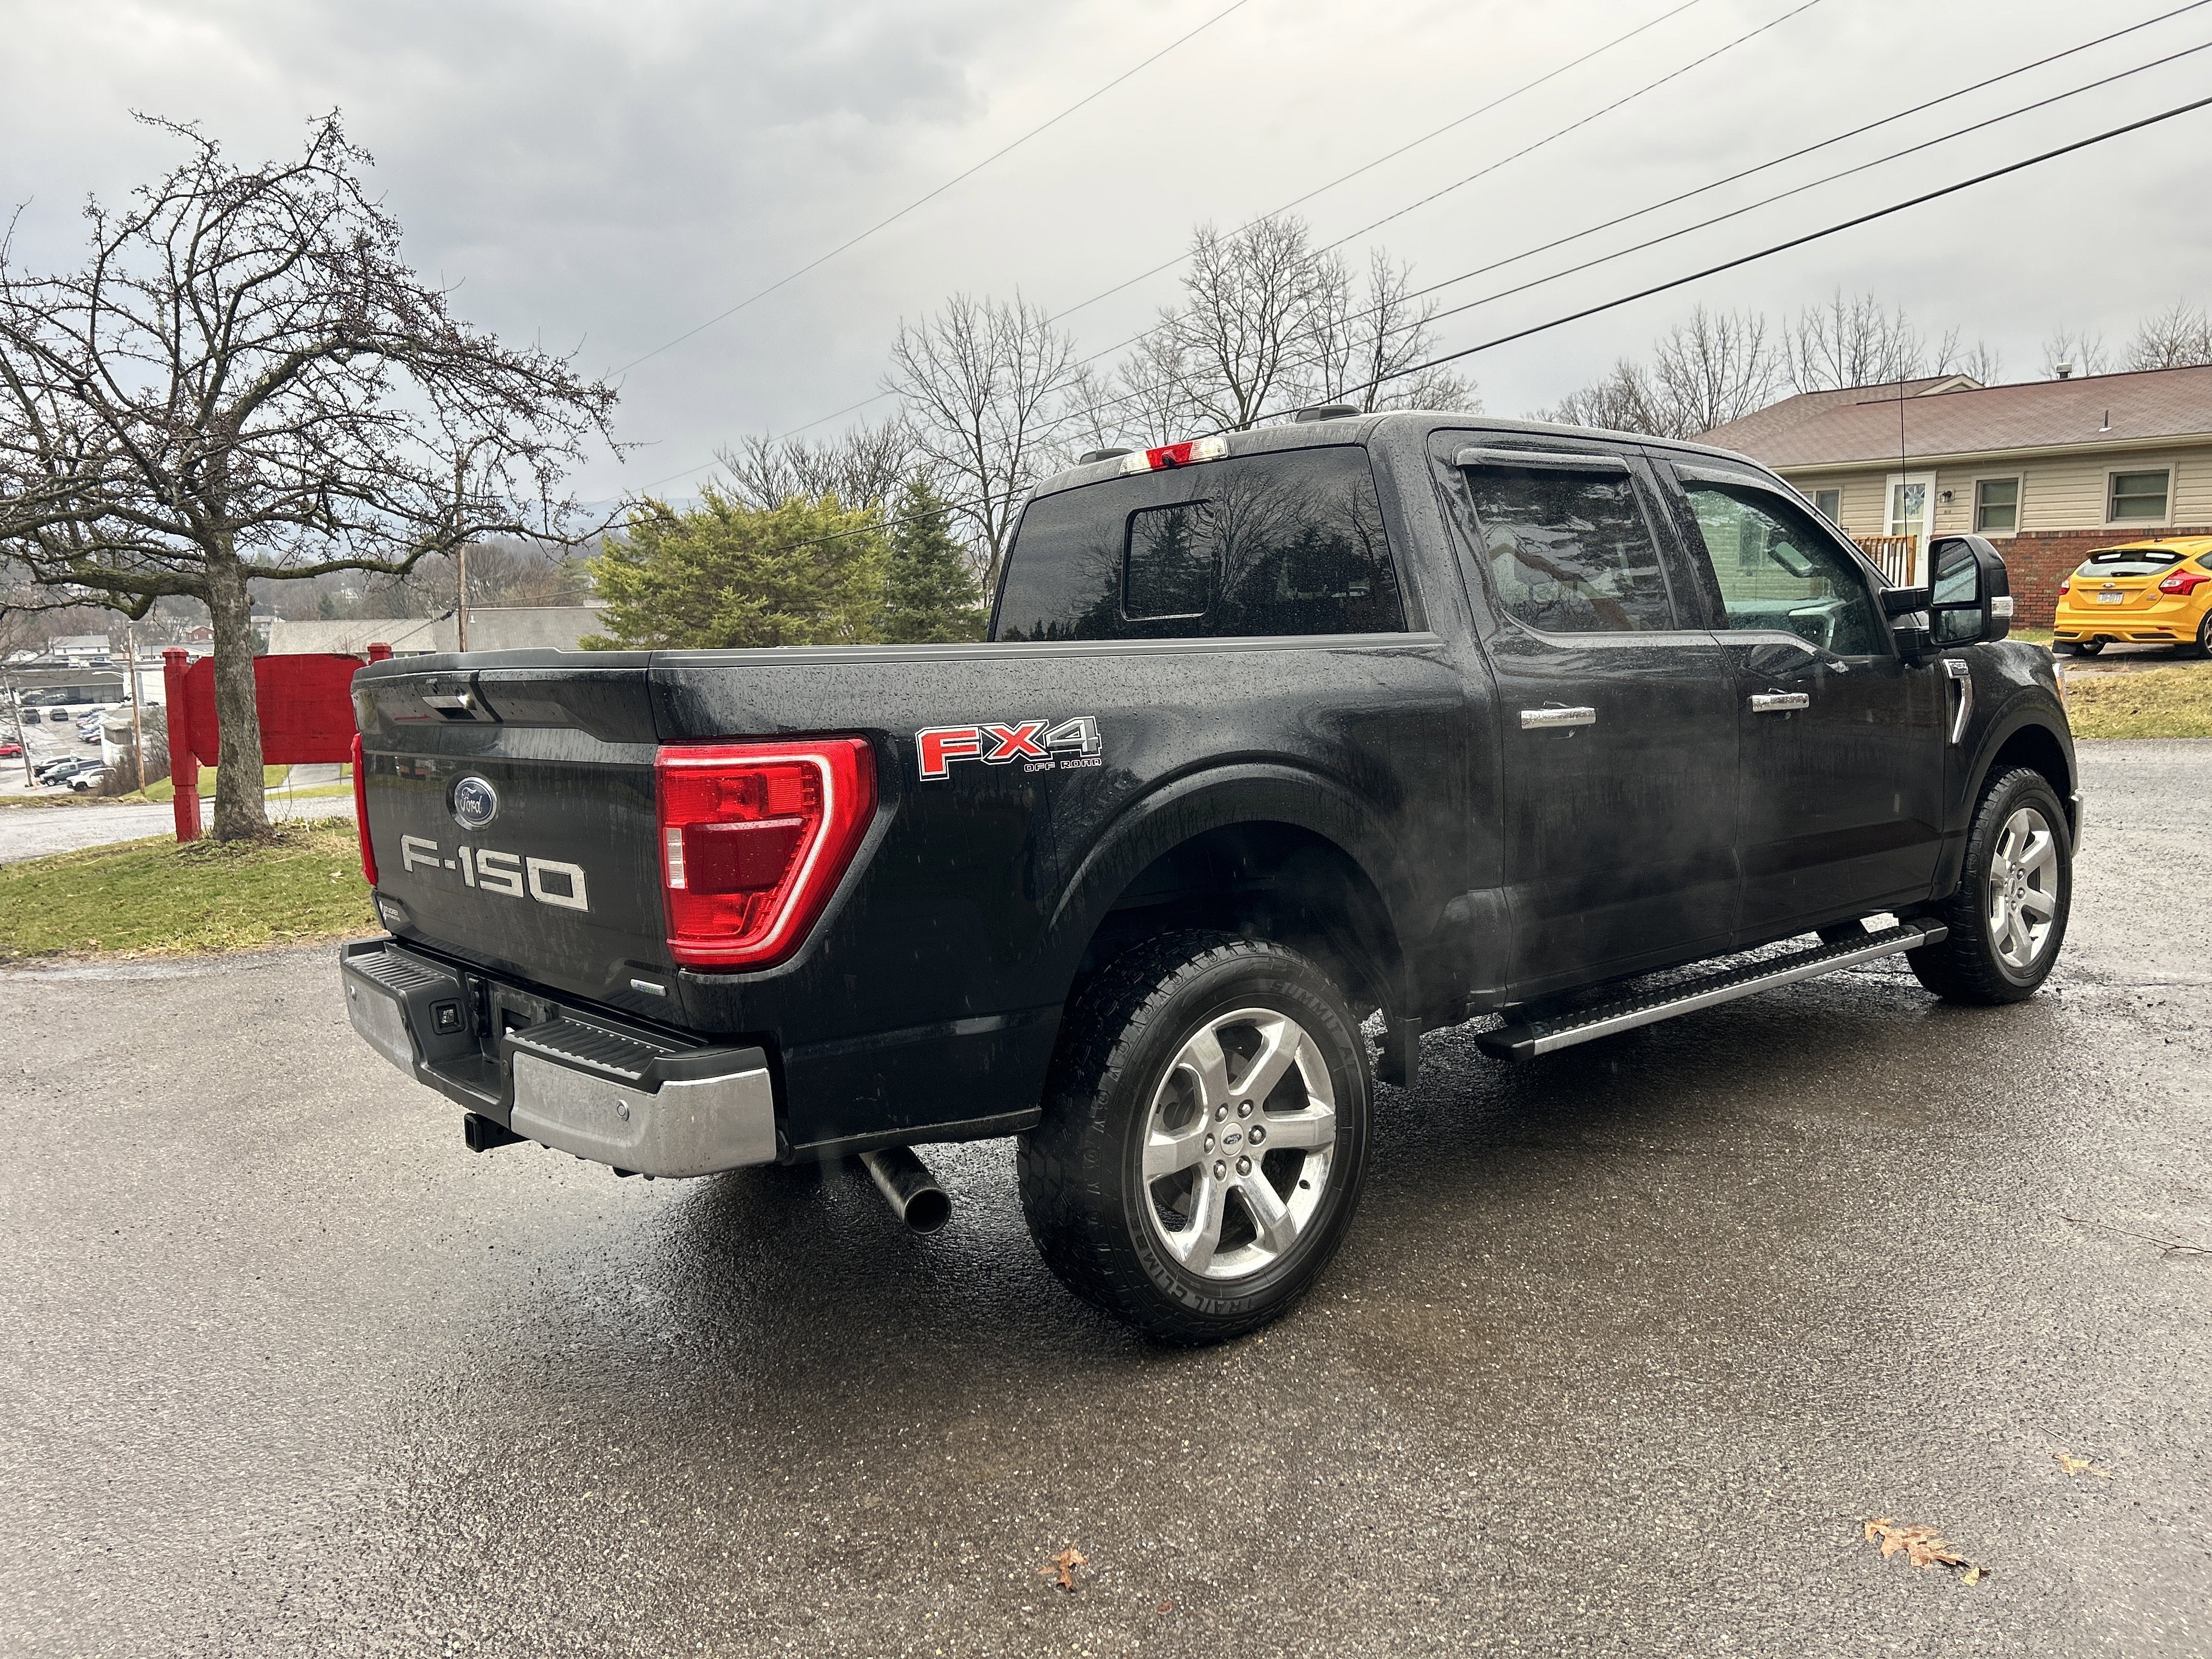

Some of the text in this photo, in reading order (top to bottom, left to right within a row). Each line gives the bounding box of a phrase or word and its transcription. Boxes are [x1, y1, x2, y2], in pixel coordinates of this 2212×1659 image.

[915, 716, 1102, 781] FX4
[1024, 757, 1102, 772] OFF ROAD
[460, 786, 483, 814] Ford
[400, 834, 590, 912] F-150
[1271, 980, 1344, 1032] SUMMIT
[1194, 1294, 1255, 1313] TRAIL
